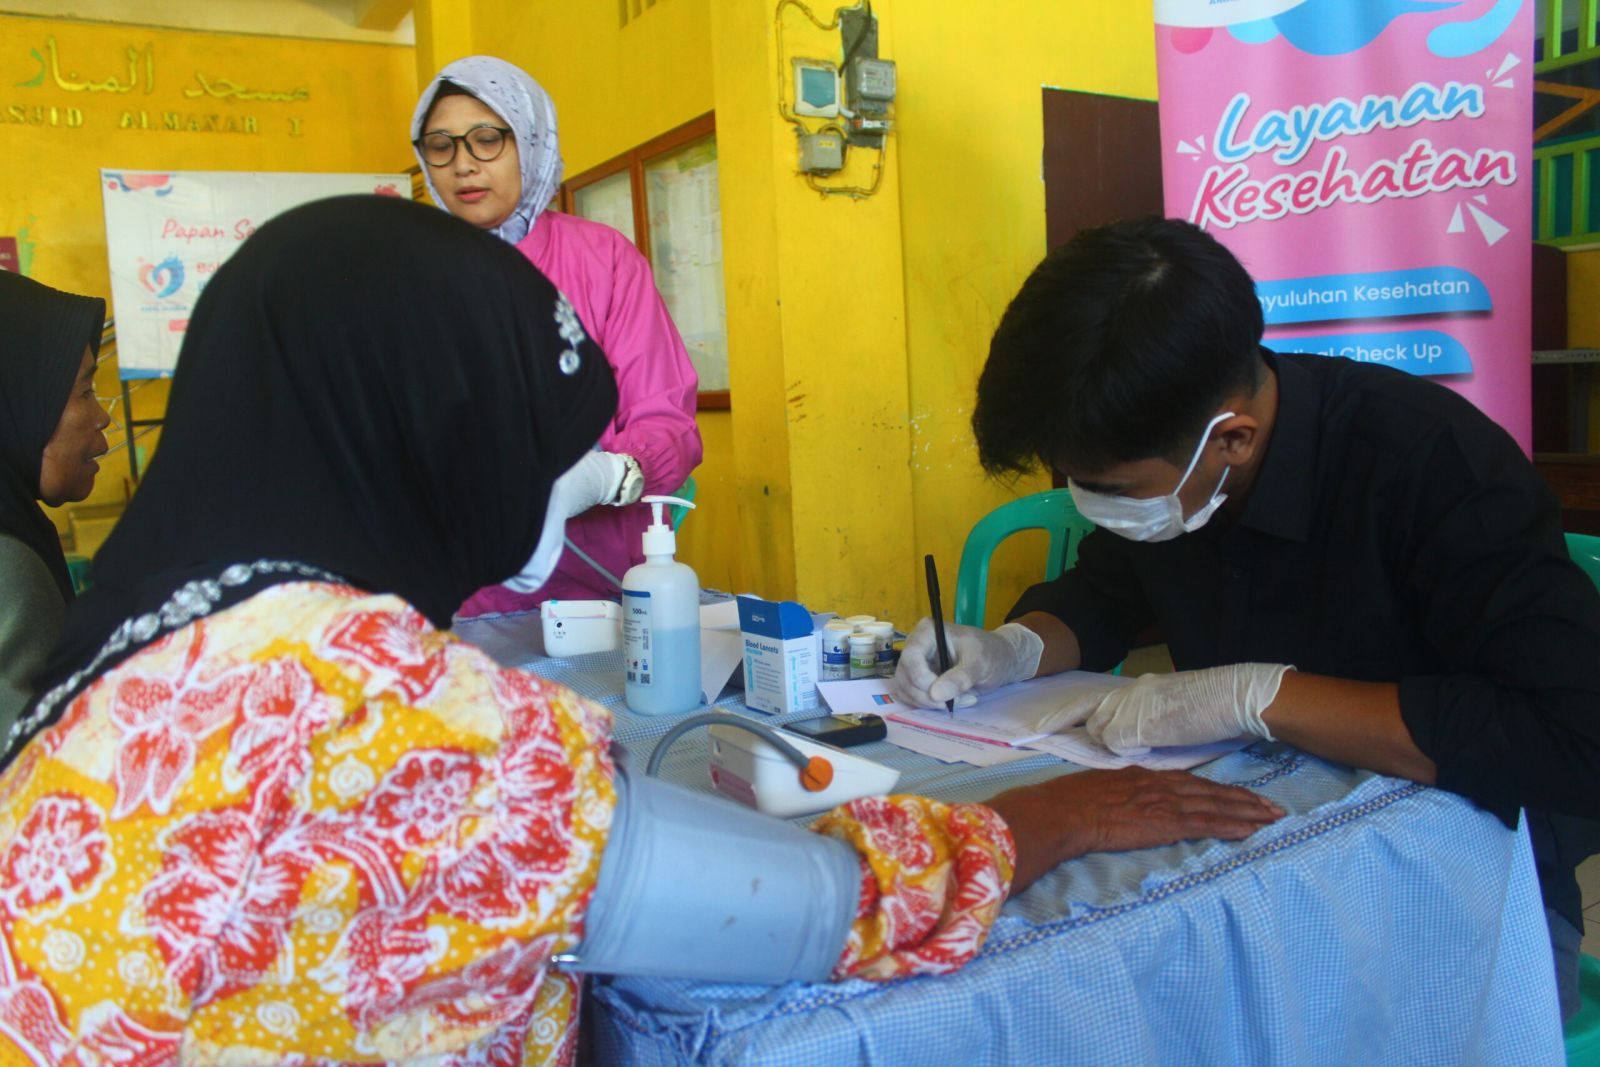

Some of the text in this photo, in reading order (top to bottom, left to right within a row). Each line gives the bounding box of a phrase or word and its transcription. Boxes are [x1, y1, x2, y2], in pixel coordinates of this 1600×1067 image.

[0, 105, 83, 128] SJID
[1214, 82, 1485, 163] Layanan
[1191, 142, 1515, 230] Kesehatan
[162, 218, 225, 245] Papan
[1353, 279, 1470, 301] Kesehatan
[1340, 344, 1408, 362] Check
[1413, 343, 1442, 364] Up
[745, 639, 759, 649] Blood
[759, 643, 779, 654] Lancets
